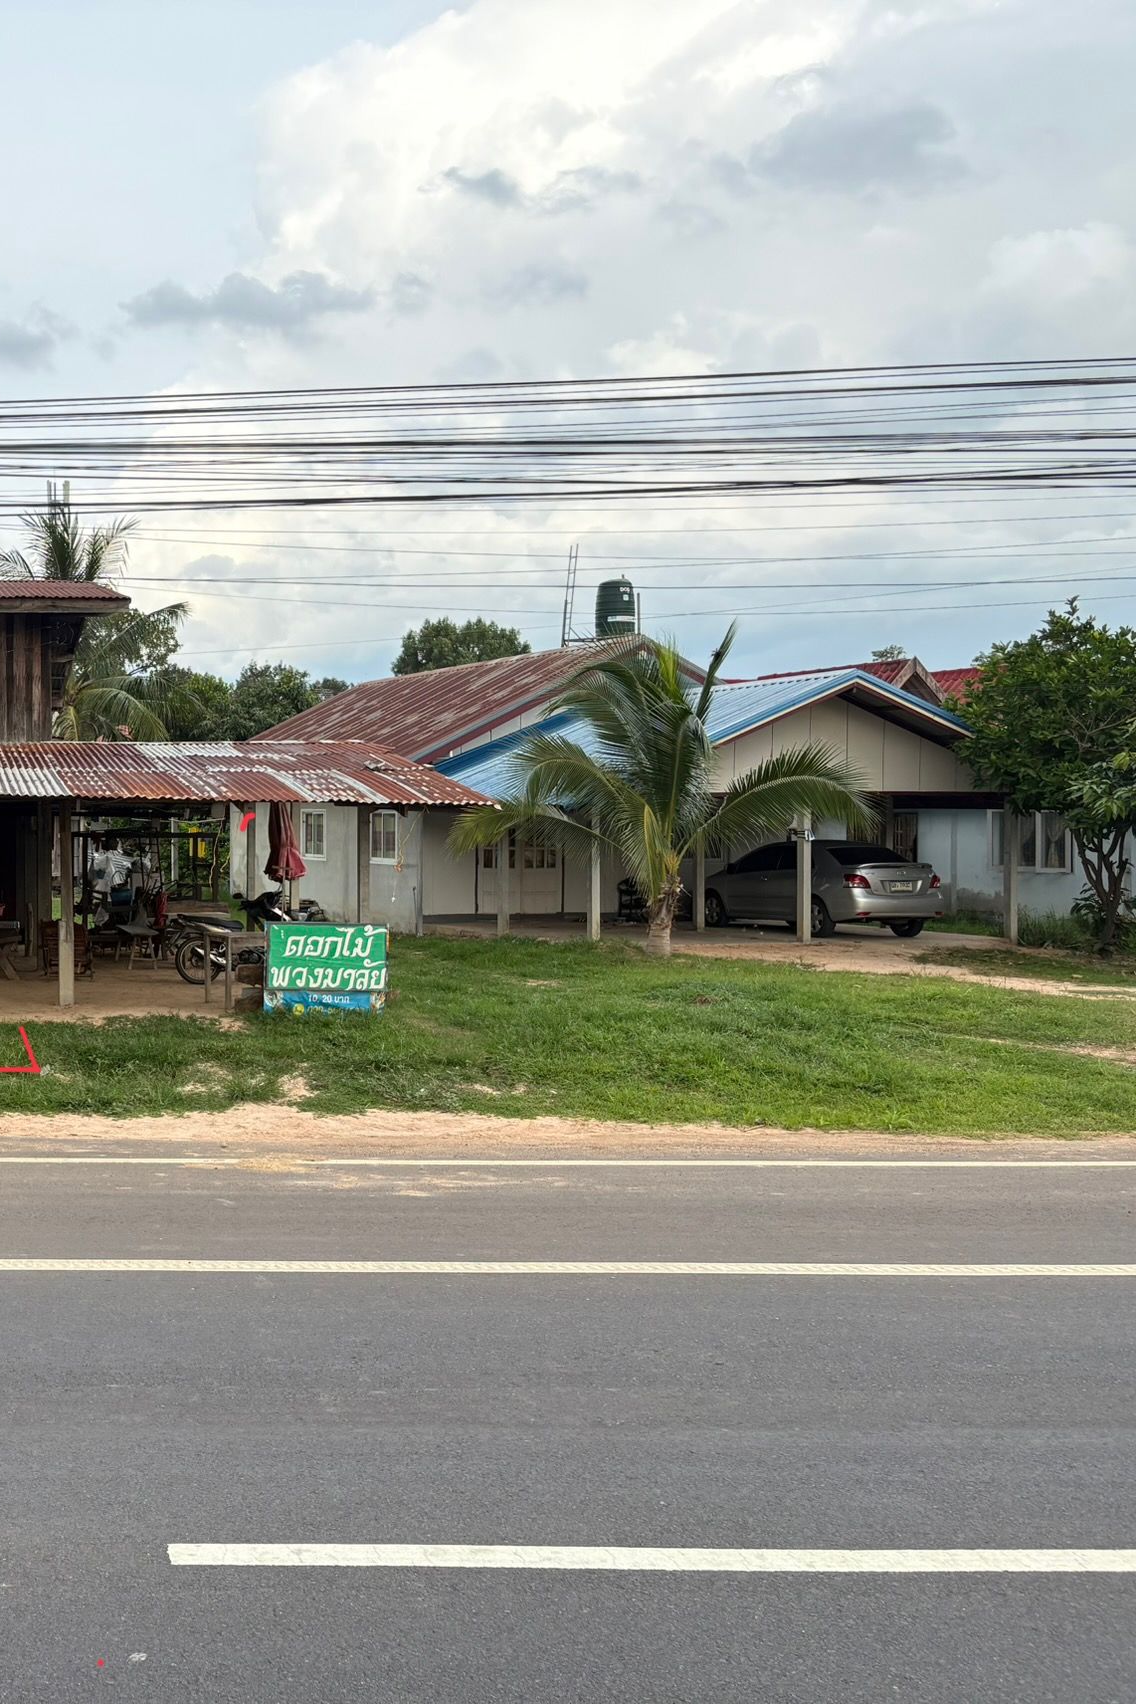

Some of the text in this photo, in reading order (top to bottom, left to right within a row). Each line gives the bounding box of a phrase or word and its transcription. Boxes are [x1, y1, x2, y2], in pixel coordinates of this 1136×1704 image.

[282, 924, 387, 958] ดอกไม้
[270, 959, 387, 991] พวงมาลัย
[322, 994, 332, 1003] 20
